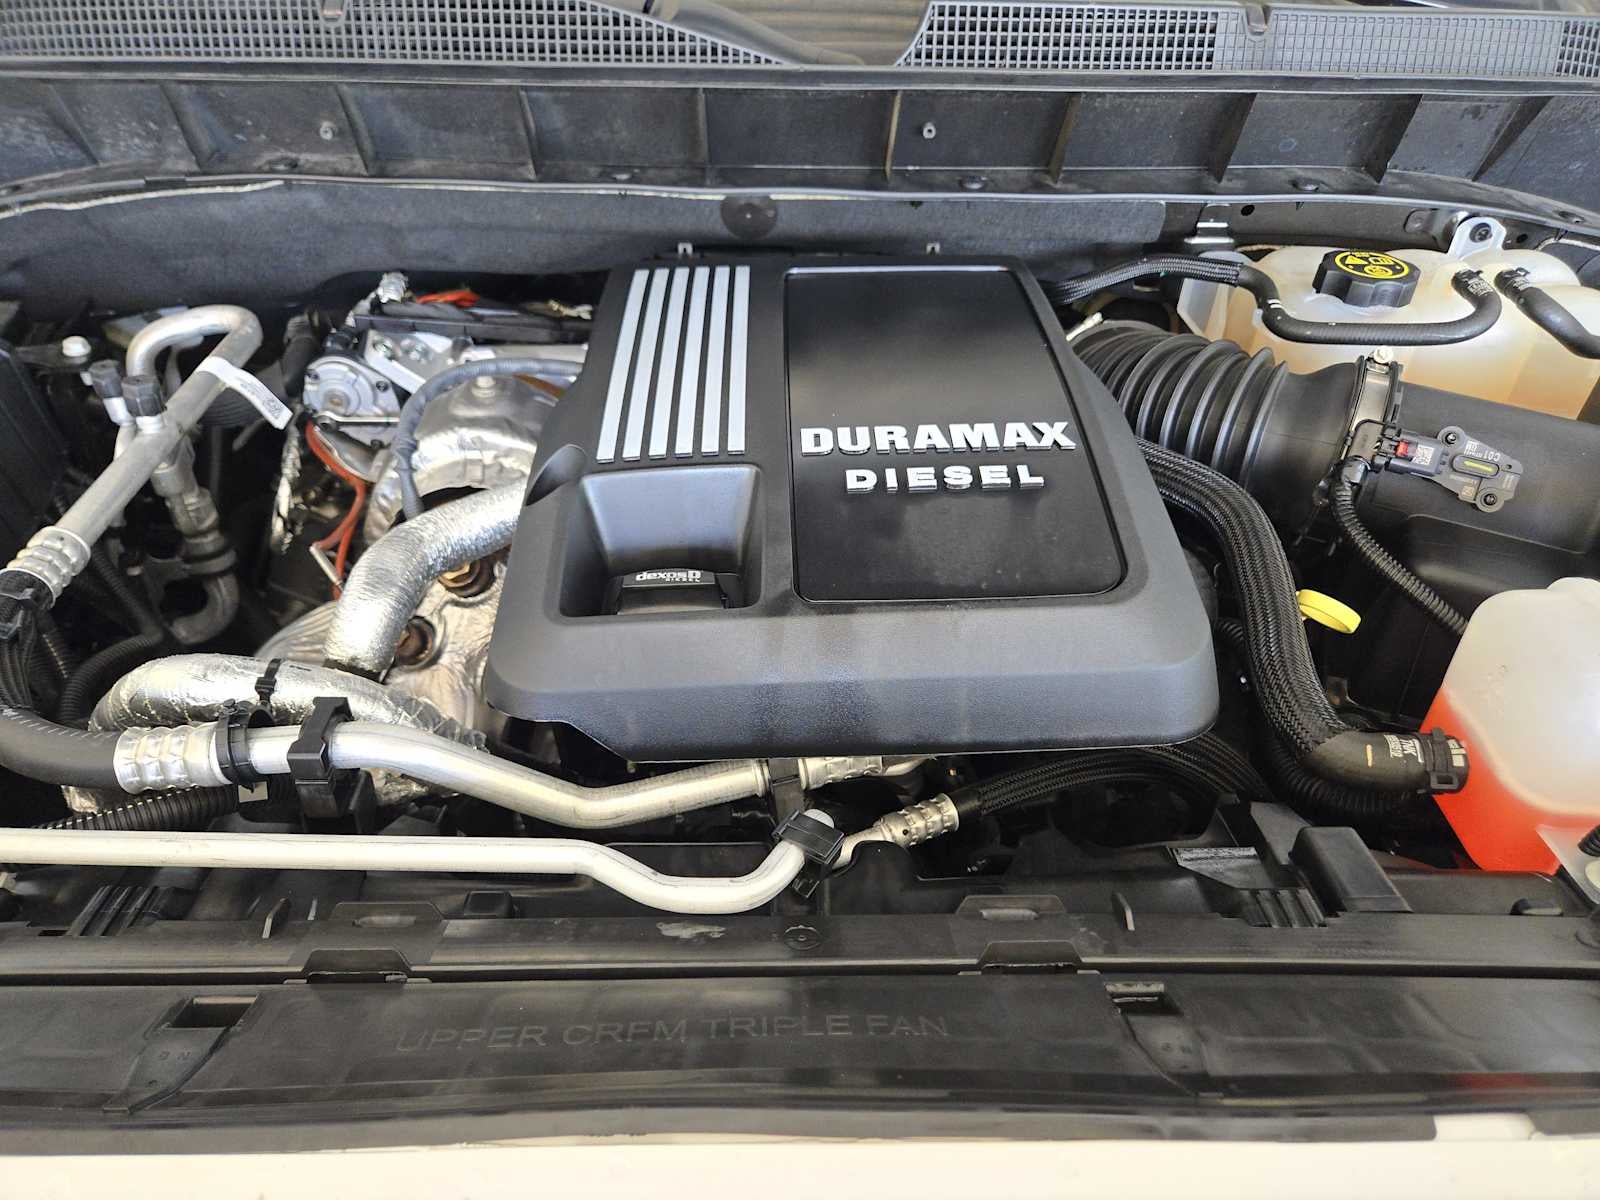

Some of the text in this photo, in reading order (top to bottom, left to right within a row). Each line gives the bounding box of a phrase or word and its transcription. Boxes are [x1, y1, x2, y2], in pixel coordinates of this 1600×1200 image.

[801, 422, 1076, 456] DURAMAX
[846, 465, 1044, 493] DIESEL
[394, 1015, 950, 1053] UPPER CRFM TRIPLE FAN
